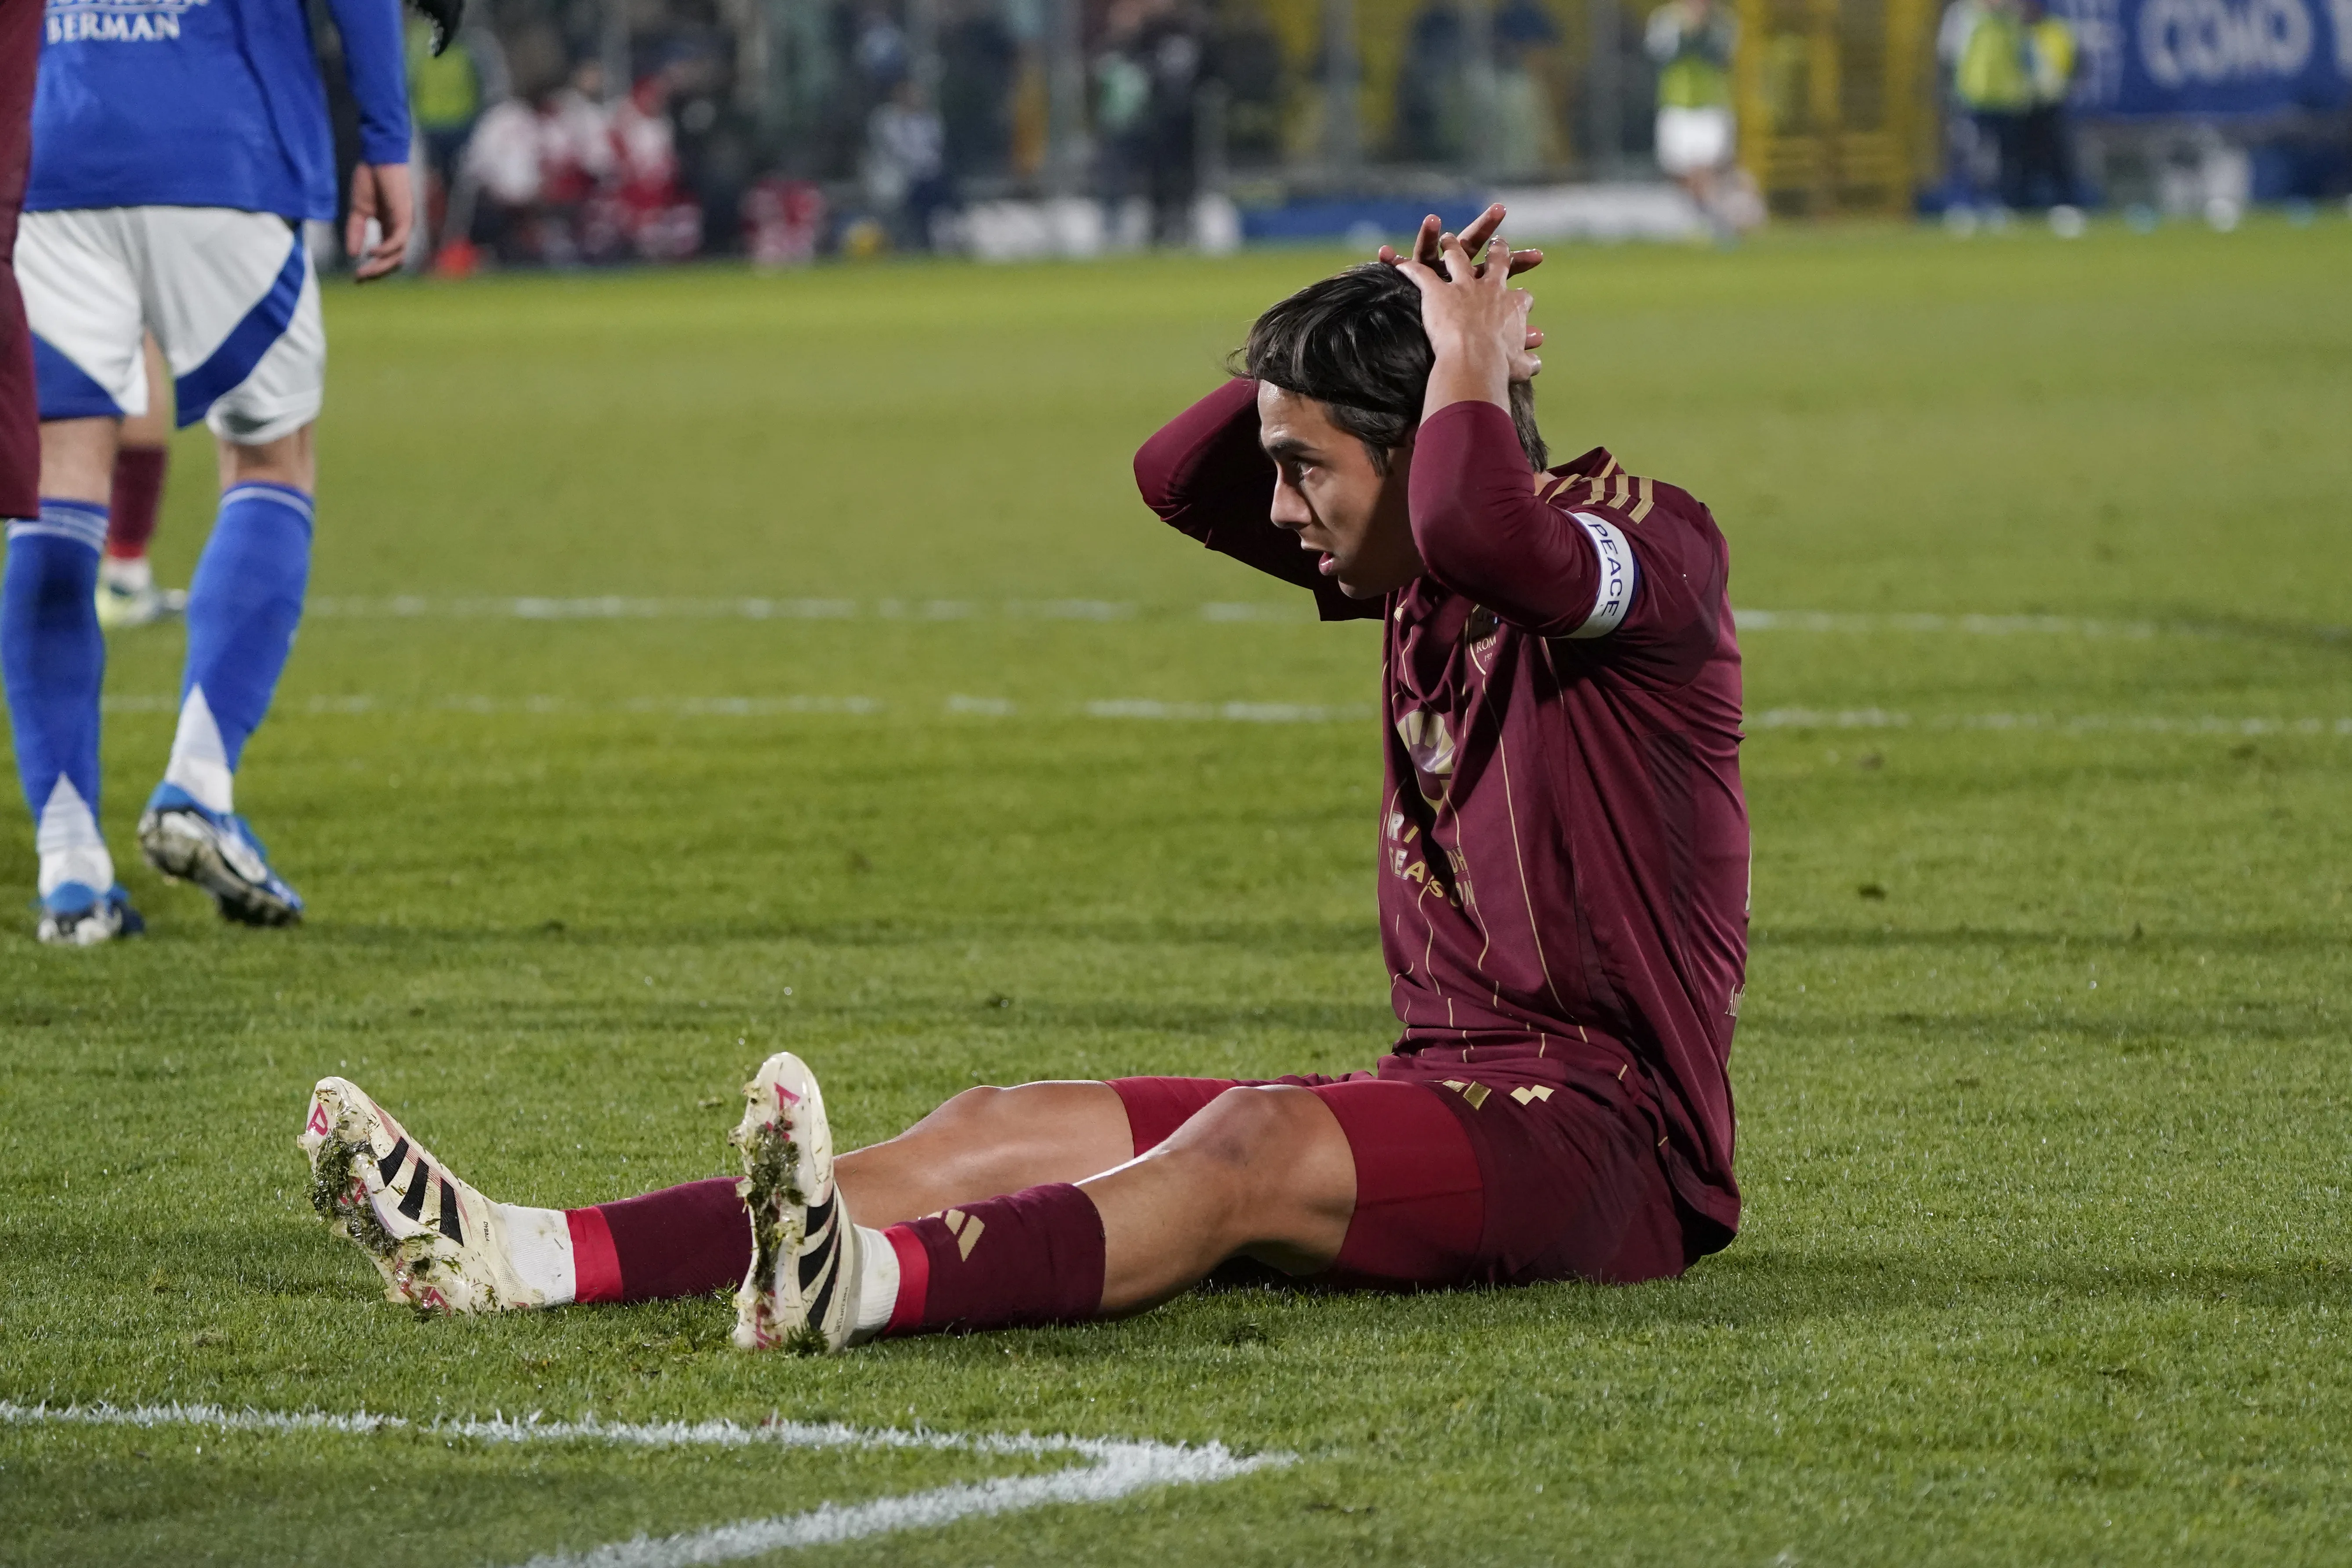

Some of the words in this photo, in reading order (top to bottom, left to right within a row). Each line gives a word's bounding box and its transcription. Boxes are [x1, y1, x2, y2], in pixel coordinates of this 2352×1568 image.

[47, 12, 181, 45] BERMAN
[1588, 524, 1622, 617] PEACE
[1477, 635, 1496, 653] ROM
